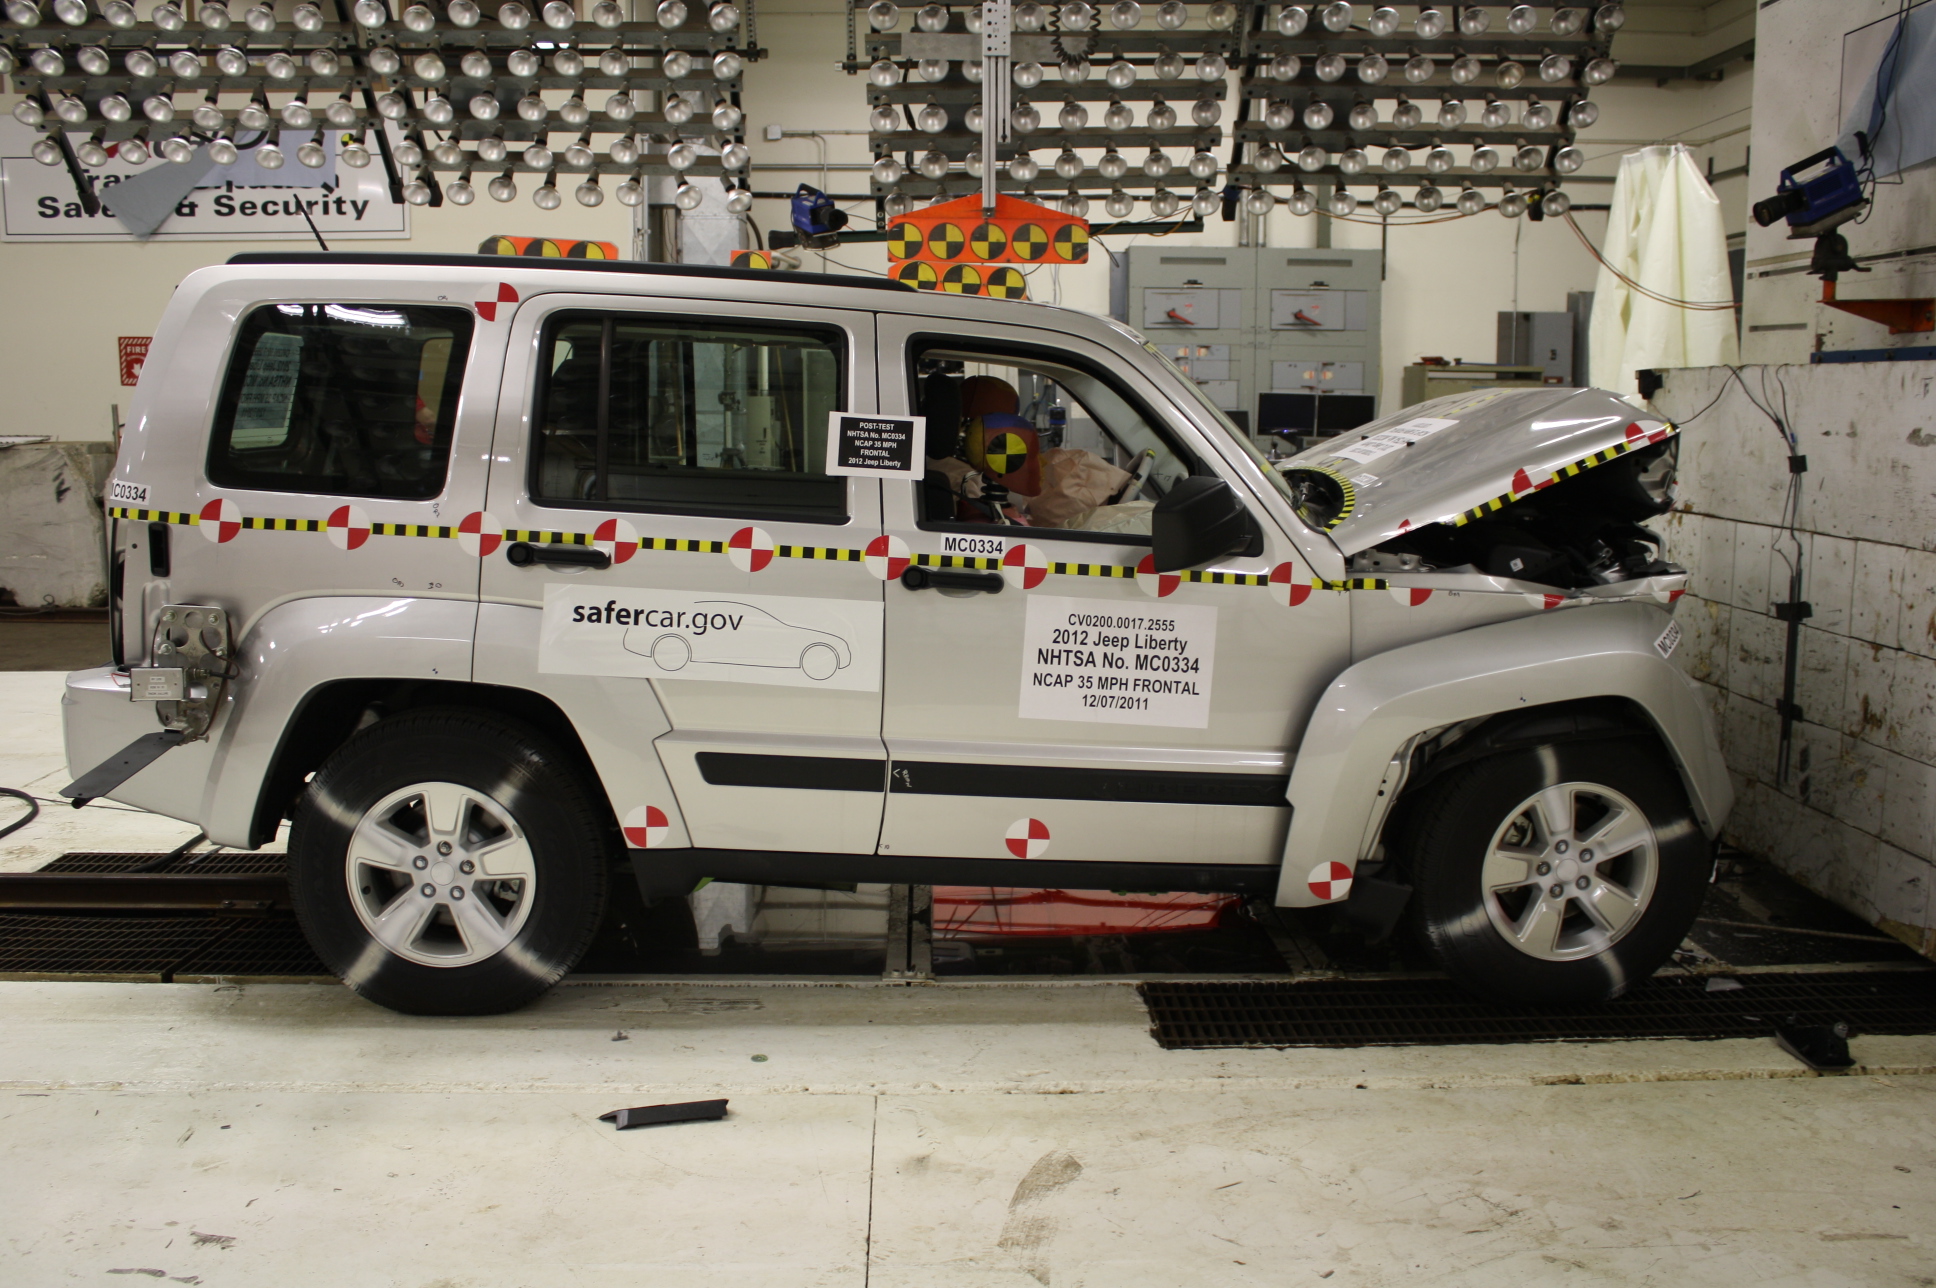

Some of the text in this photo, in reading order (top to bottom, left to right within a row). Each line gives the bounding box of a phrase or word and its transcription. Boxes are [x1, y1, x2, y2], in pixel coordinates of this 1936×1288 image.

[213, 194, 370, 221] Security
[127, 346, 146, 354] FIRE
[847, 430, 869, 438] NHTSA
[870, 431, 880, 439] No.
[859, 422, 895, 431] POST-TEST
[860, 449, 890, 457] FRONTAL
[882, 441, 897, 449] MPH
[848, 457, 902, 468] 2012 Jeep Liberty
[944, 537, 1004, 555] MC0334
[572, 600, 743, 636] safercar.gov
[1068, 613, 1176, 632] CV0200.0017.2555
[1052, 628, 1188, 656] 2012 Jeep Liberty
[1037, 648, 1200, 674] NHTSA No. MC0334
[1033, 672, 1200, 696] NCAP 35 MPH FRONTAL
[1081, 694, 1149, 711] 12/07/2011
